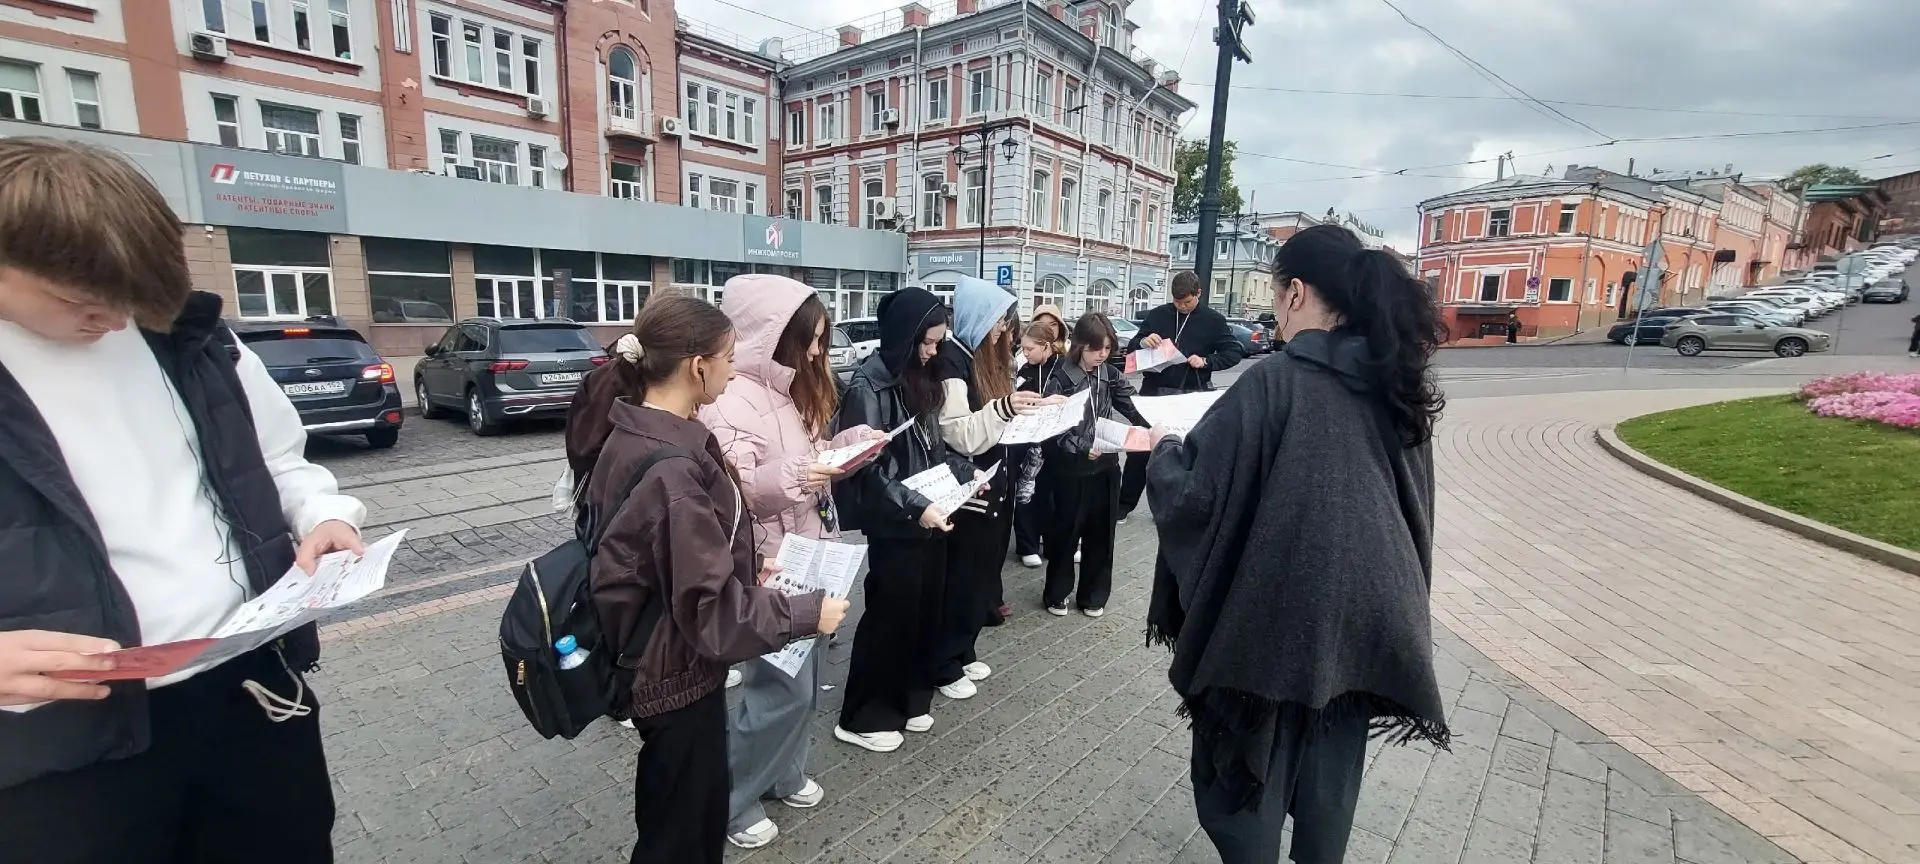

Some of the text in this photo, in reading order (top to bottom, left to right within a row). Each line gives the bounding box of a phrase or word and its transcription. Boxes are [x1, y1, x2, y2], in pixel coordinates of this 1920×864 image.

[244, 171, 281, 182] ПЕТУХОВ
[293, 177, 336, 188] ПАРТНЕРЫ
[237, 203, 319, 217] ПАТЕНТНЫЕ СПОРЫ
[929, 253, 963, 265] raumplus
[1000, 267, 1009, 284] P
